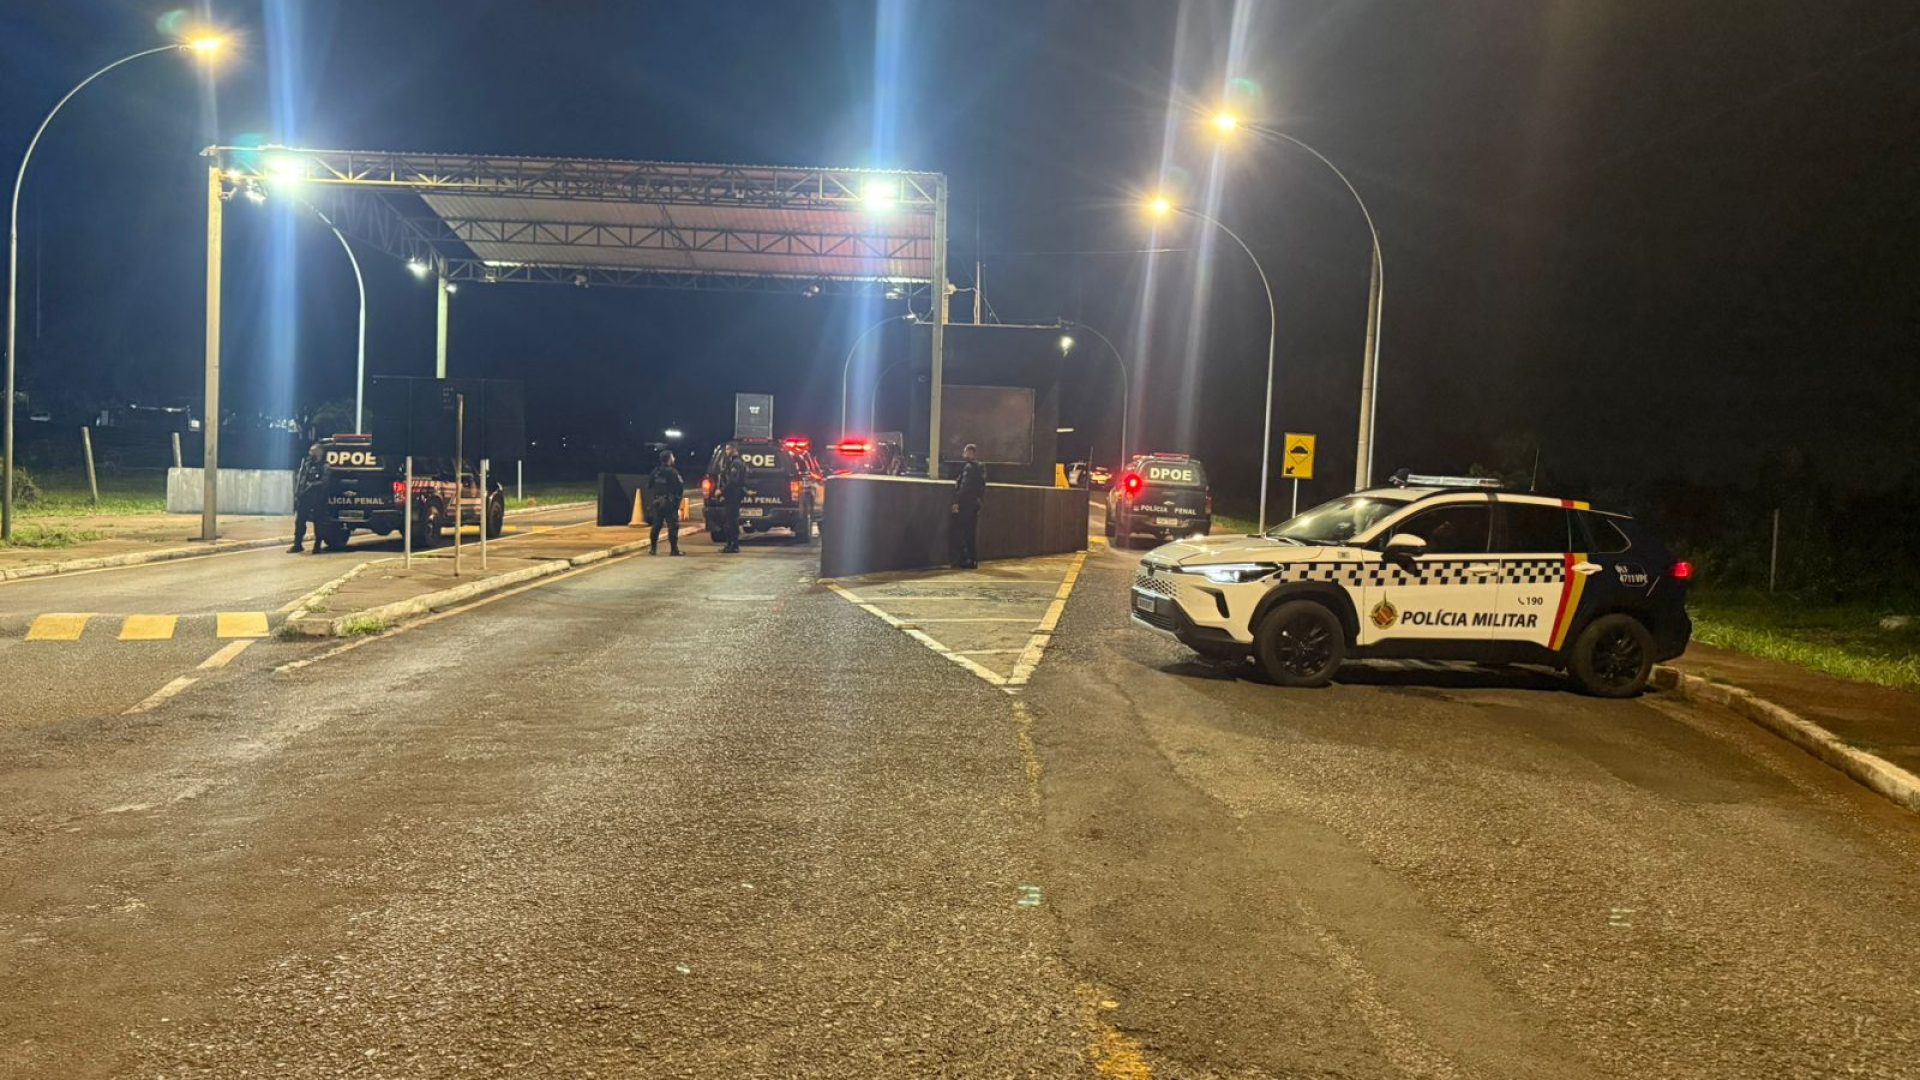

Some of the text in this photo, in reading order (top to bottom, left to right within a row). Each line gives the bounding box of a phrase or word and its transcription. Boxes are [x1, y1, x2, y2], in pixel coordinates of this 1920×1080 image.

[326, 451, 377, 465] DPOE
[741, 454, 775, 467] POE
[1150, 467, 1192, 481] DPOE
[328, 495, 384, 505] LÍCIA PENAL
[1174, 507, 1197, 516] PENAL
[1526, 596, 1543, 606] 190
[1400, 609, 1538, 628] POLÍCIA MILITAR
